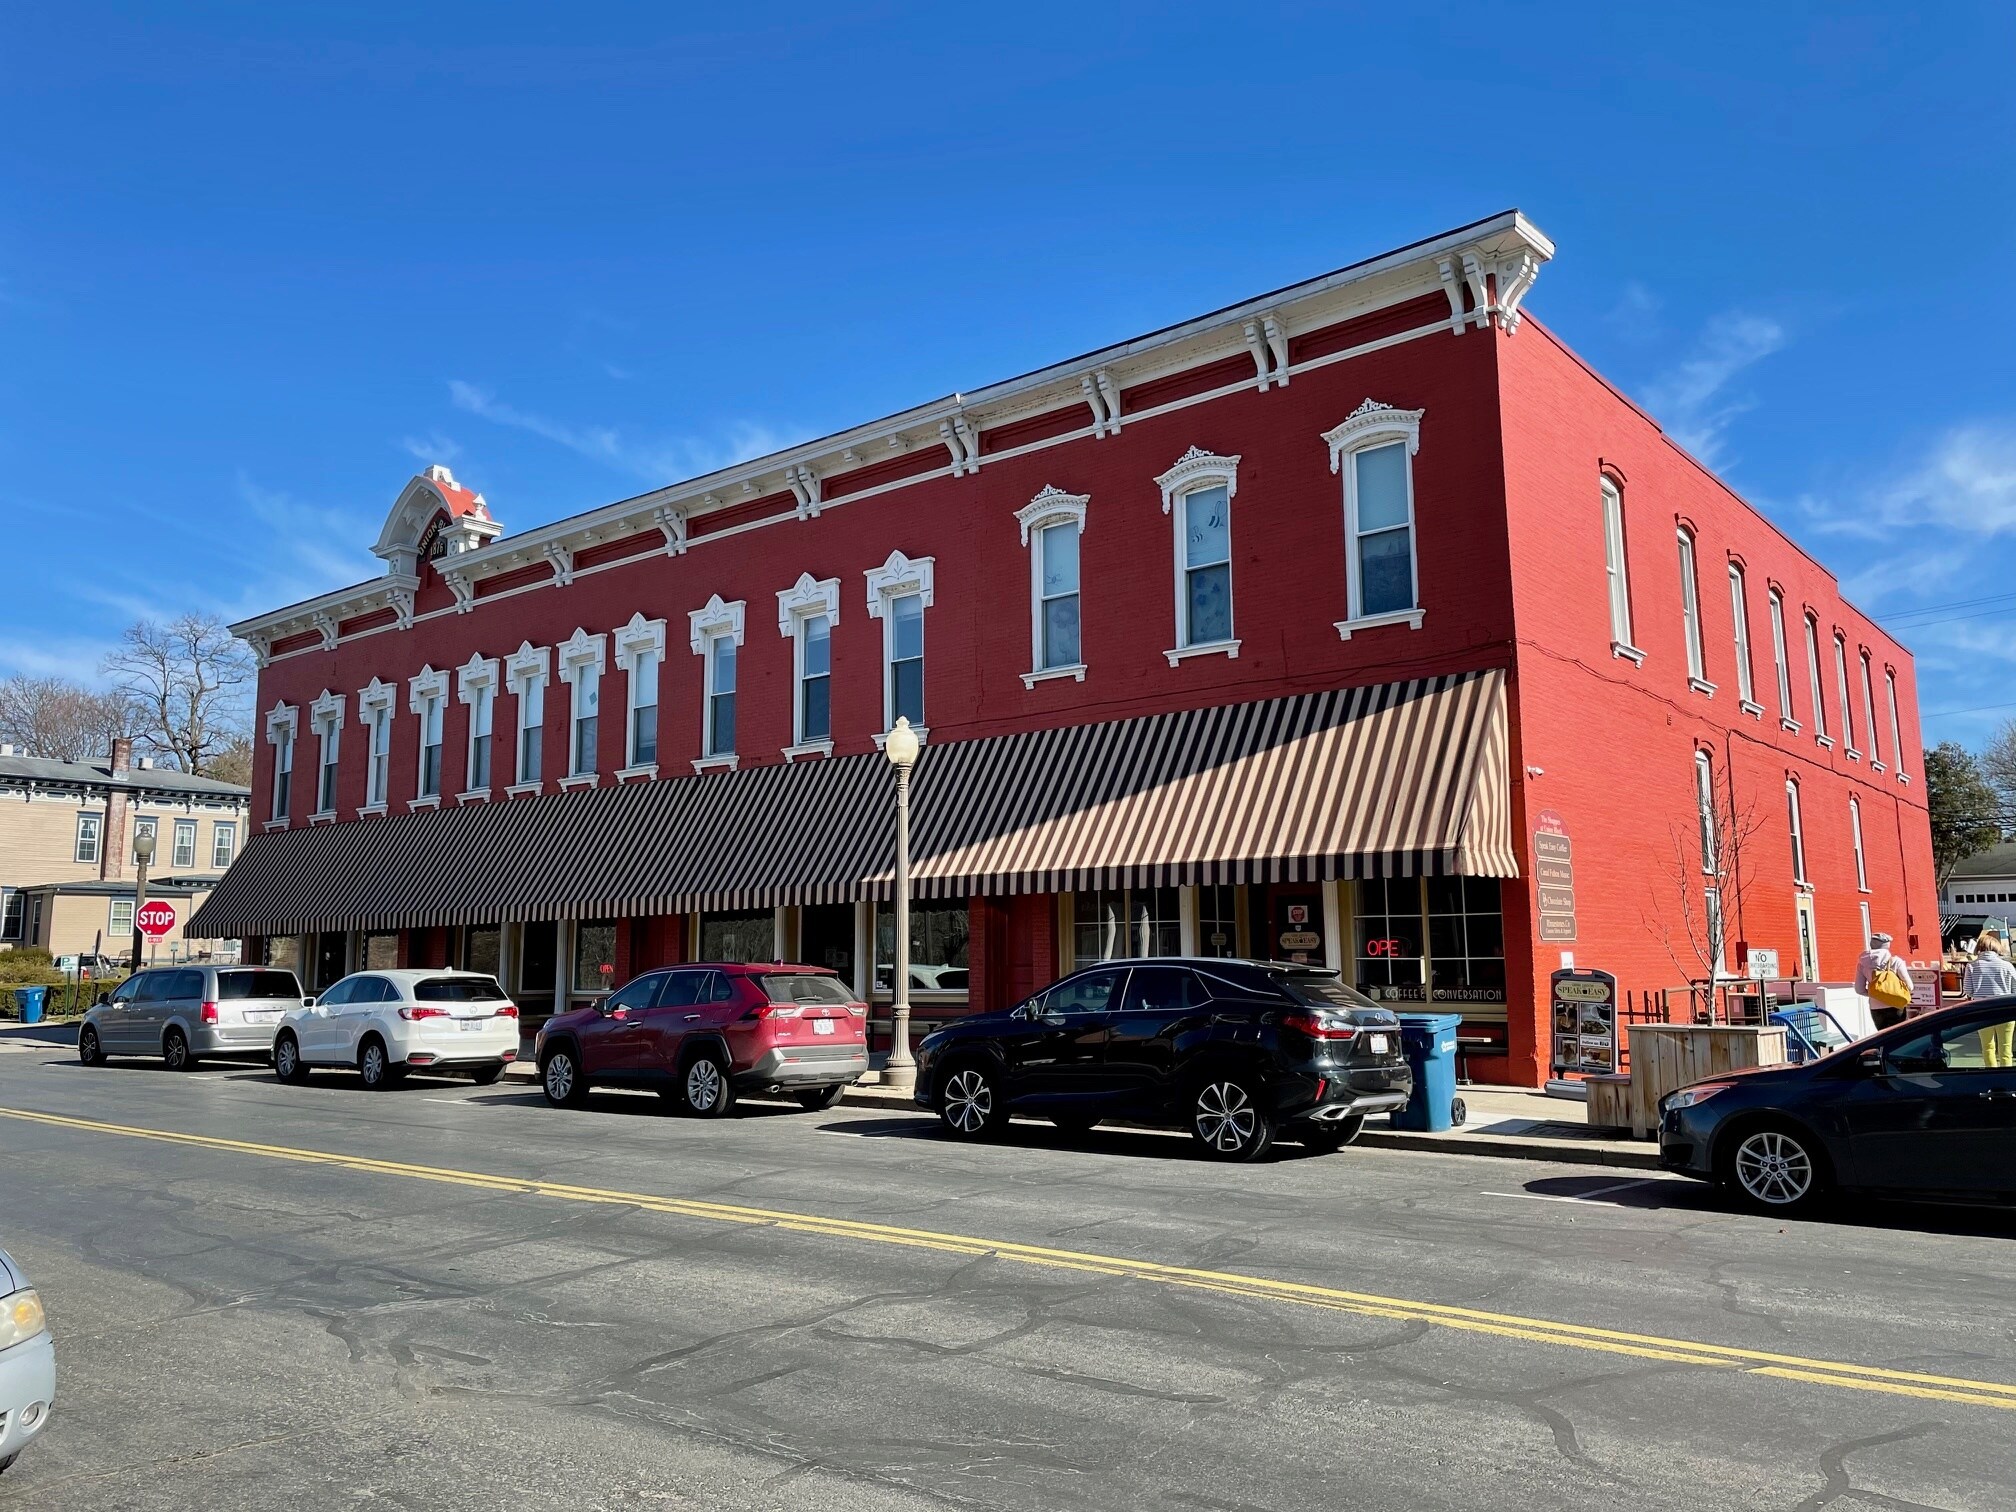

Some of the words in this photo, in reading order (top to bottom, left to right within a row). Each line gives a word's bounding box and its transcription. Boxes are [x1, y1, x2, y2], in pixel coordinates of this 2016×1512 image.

[419, 522, 437, 555] UNION
[430, 542, 443, 555] 1876
[139, 911, 174, 926] STOP
[1367, 940, 1407, 956] OPE
[61, 957, 70, 966] P
[1755, 952, 1767, 962] NO
[600, 964, 614, 974] OPEN
[1385, 988, 1418, 999] COFFEE
[1432, 989, 1502, 1000] CONVERSATION
[1557, 986, 1582, 995] SPEAK
[1588, 987, 1606, 996] EASY
